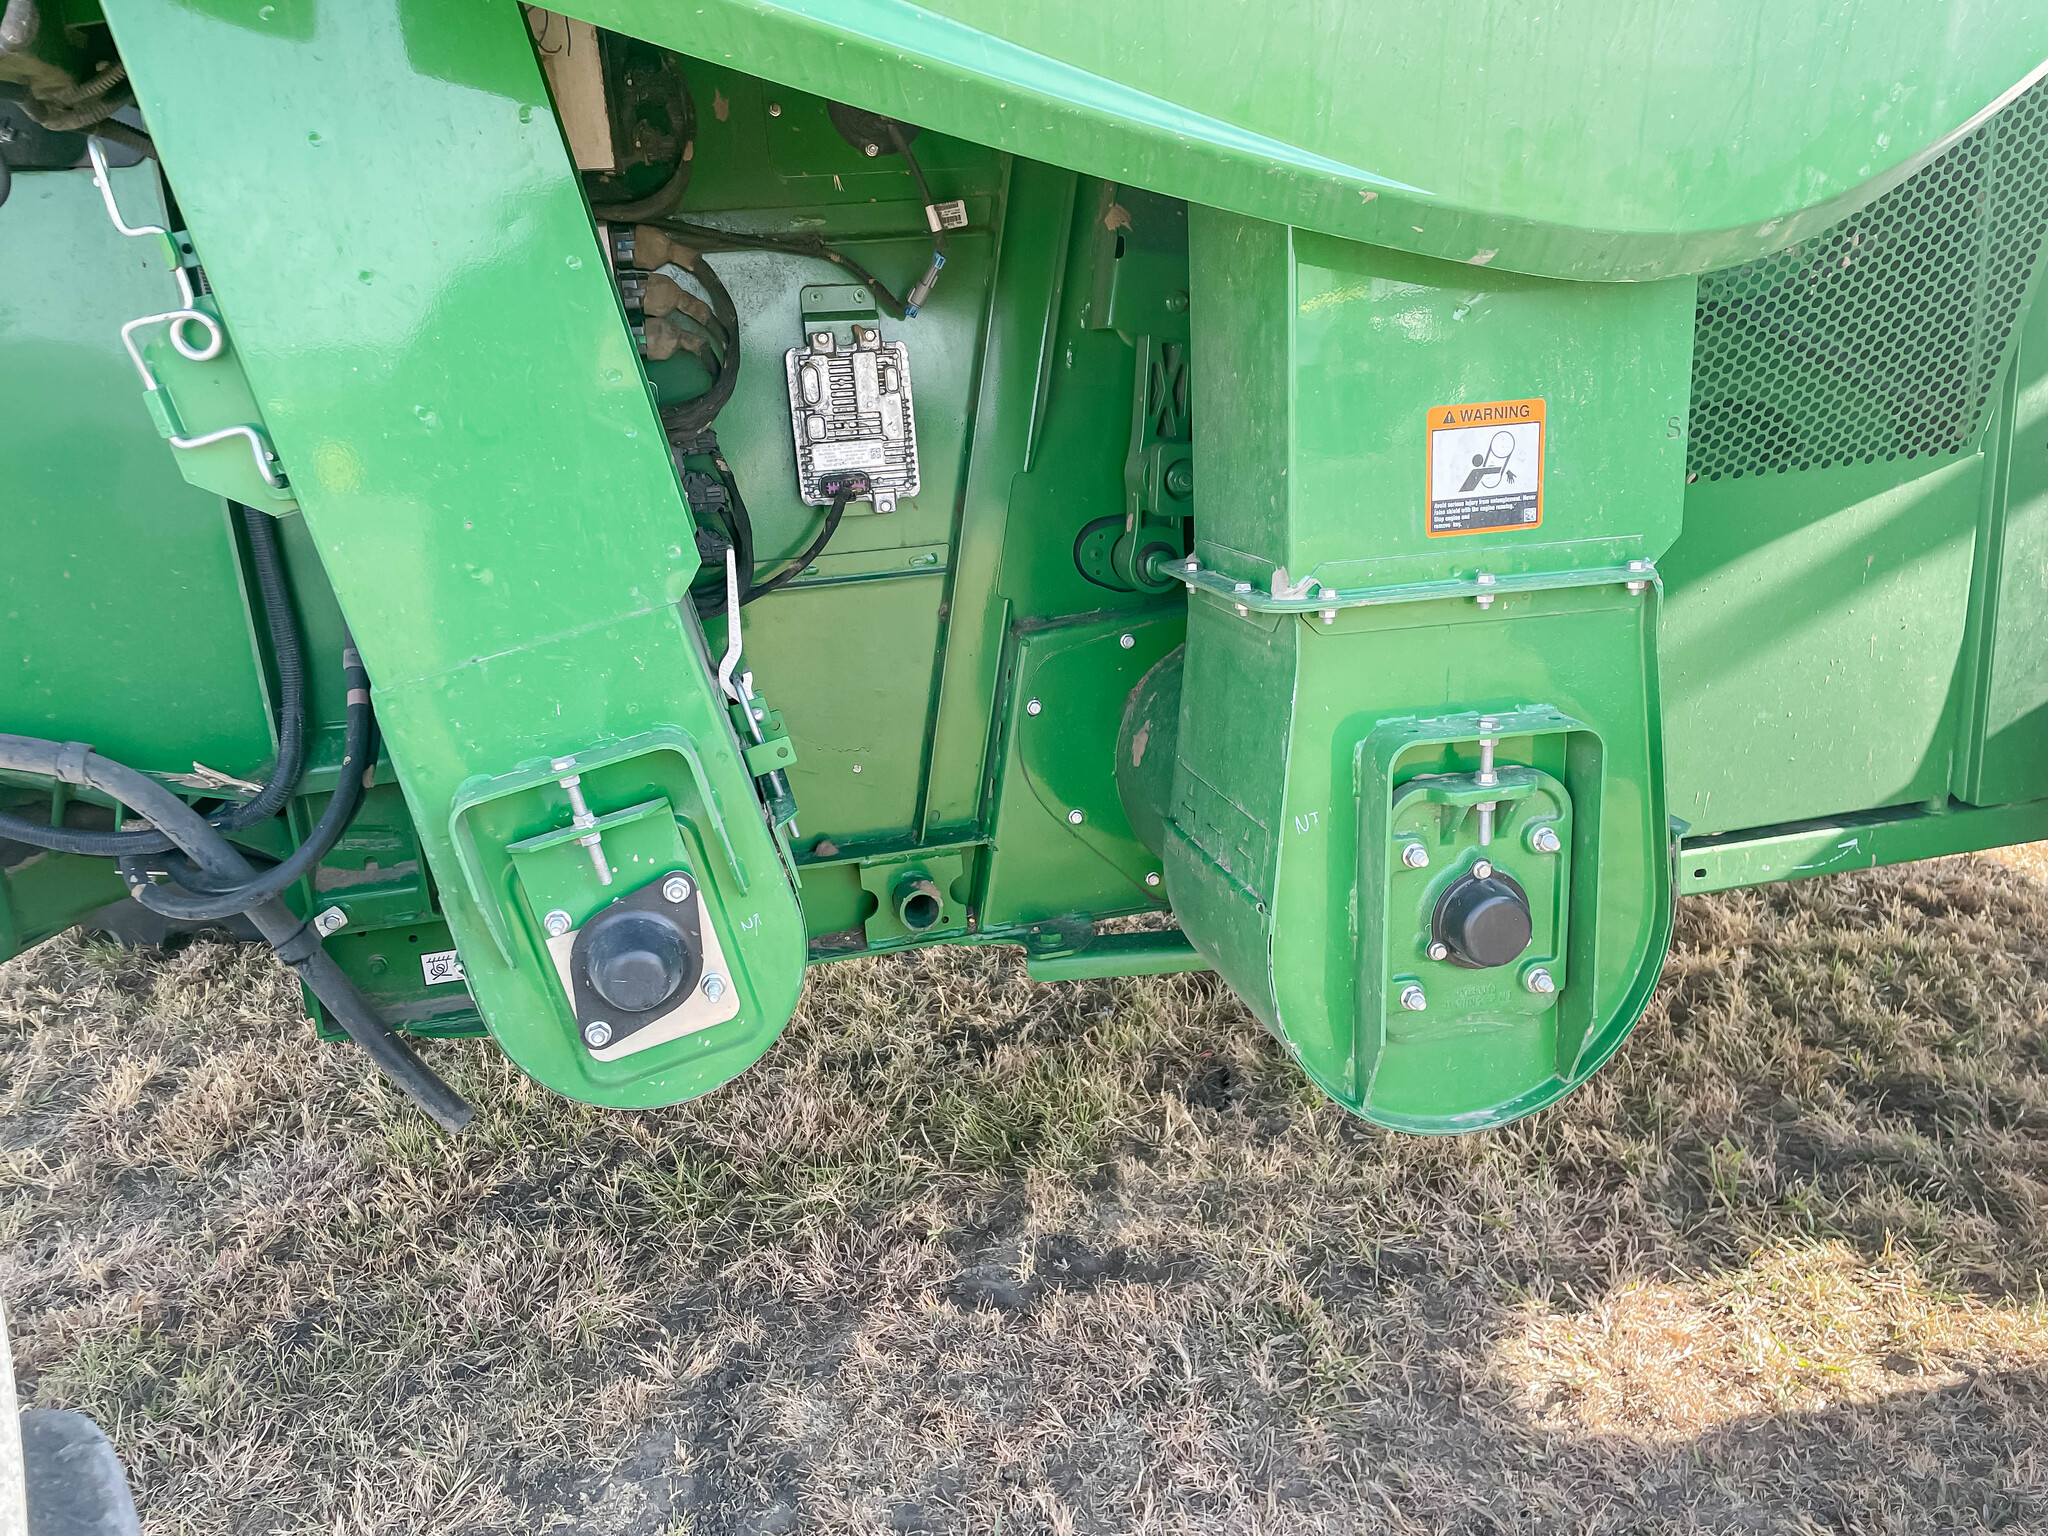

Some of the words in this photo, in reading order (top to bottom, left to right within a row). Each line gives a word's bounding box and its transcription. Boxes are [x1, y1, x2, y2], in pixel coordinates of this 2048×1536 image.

[1460, 404, 1530, 422] WARNING
[1479, 505, 1495, 513] engine
[1294, 811, 1319, 835] NT
